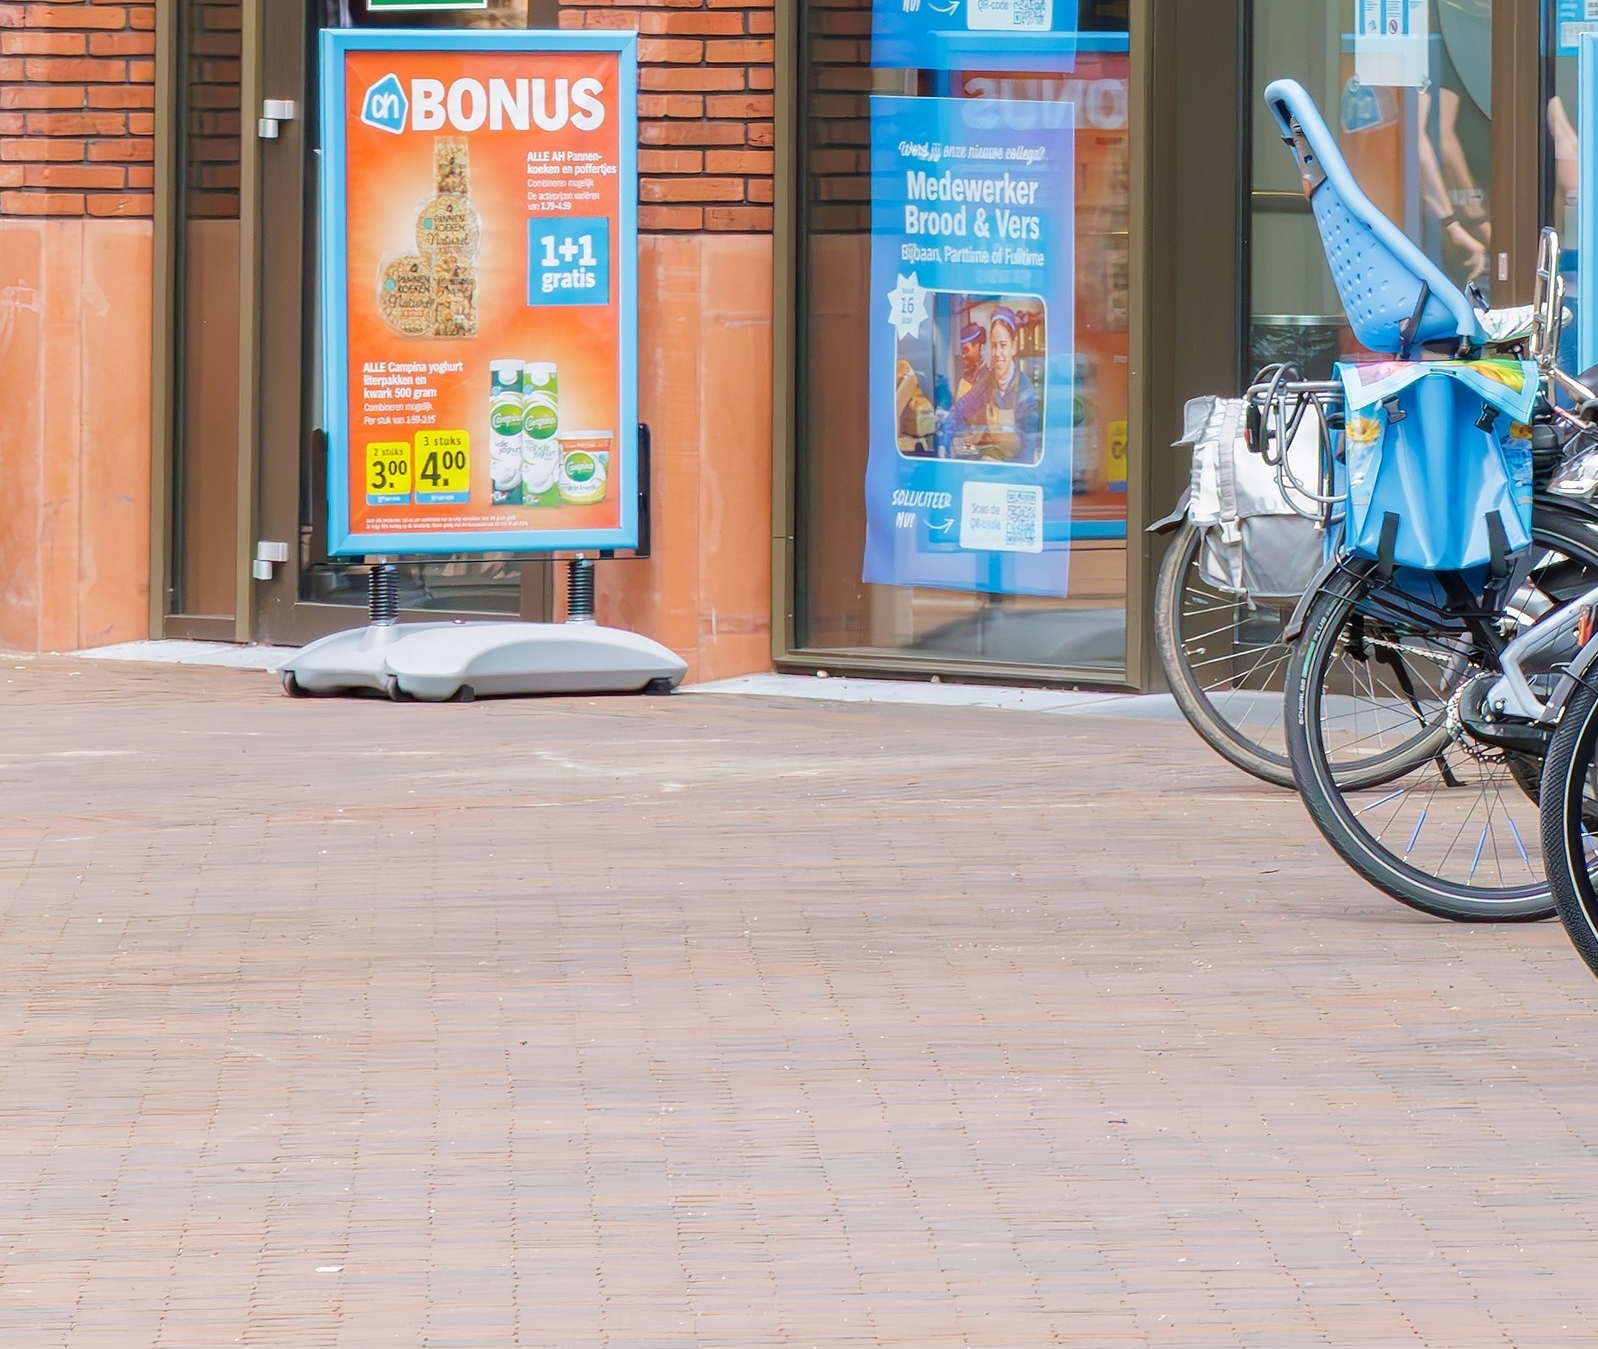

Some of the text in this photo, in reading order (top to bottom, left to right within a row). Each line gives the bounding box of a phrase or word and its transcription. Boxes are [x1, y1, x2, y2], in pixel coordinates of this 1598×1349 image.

[411, 78, 605, 132] BONUS
[527, 151, 602, 162] ALLE AH Pannen-
[527, 163, 617, 176] koeken en poffertjes
[907, 170, 1038, 205] Medewerker
[905, 205, 1039, 240] Brood & Vers
[541, 234, 597, 266] 1+1
[902, 243, 1044, 267] Bijbaan, Parttime of Fulltime
[542, 267, 595, 293] gratis
[363, 361, 463, 376] ALLE Campina yoghurt
[364, 388, 437, 400] kwark 500 gram
[374, 448, 403, 456] 2 stuks
[424, 436, 461, 446] 3 stuks
[371, 460, 408, 489] 3.00
[420, 451, 465, 487] 4.00
